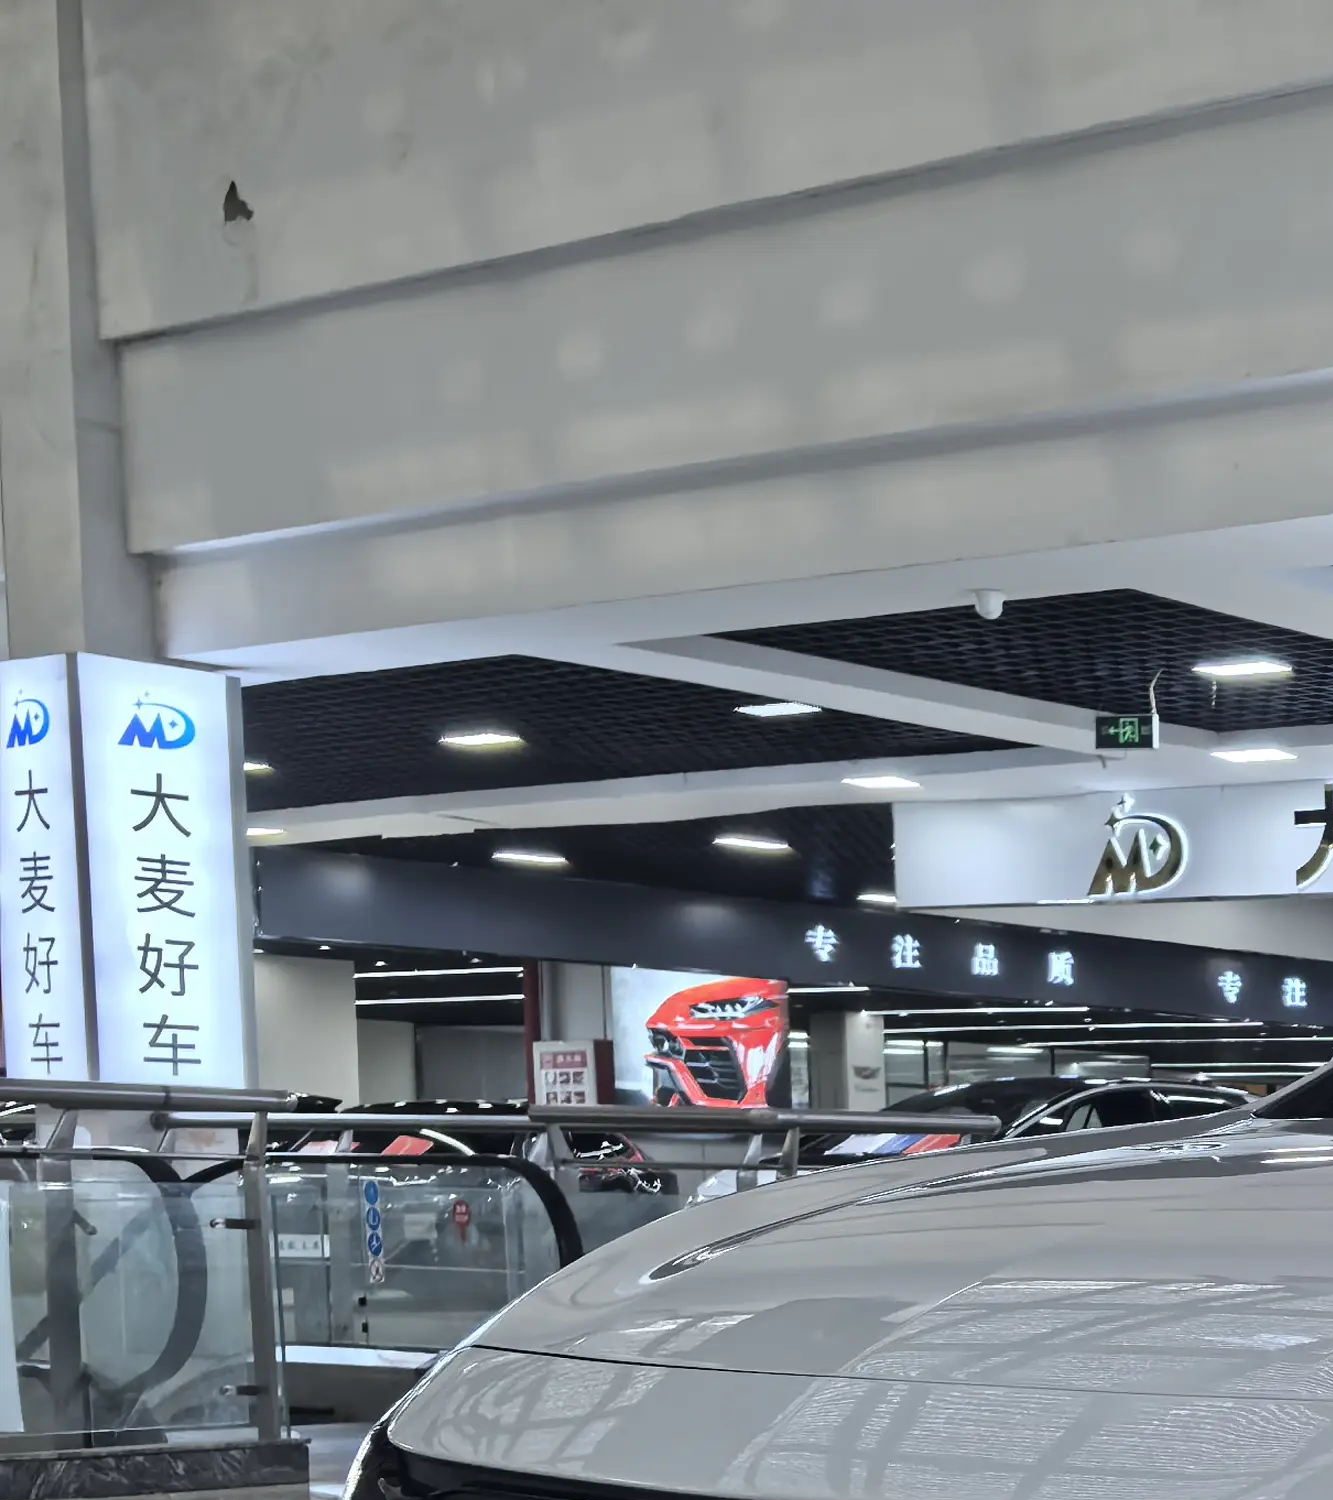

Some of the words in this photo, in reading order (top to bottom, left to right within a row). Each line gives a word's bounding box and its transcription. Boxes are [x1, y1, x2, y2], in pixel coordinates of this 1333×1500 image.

[14, 769, 64, 1075] 大麦好车
[130, 772, 202, 1077] 大麦好车
[804, 924, 1075, 987] 专注品质
